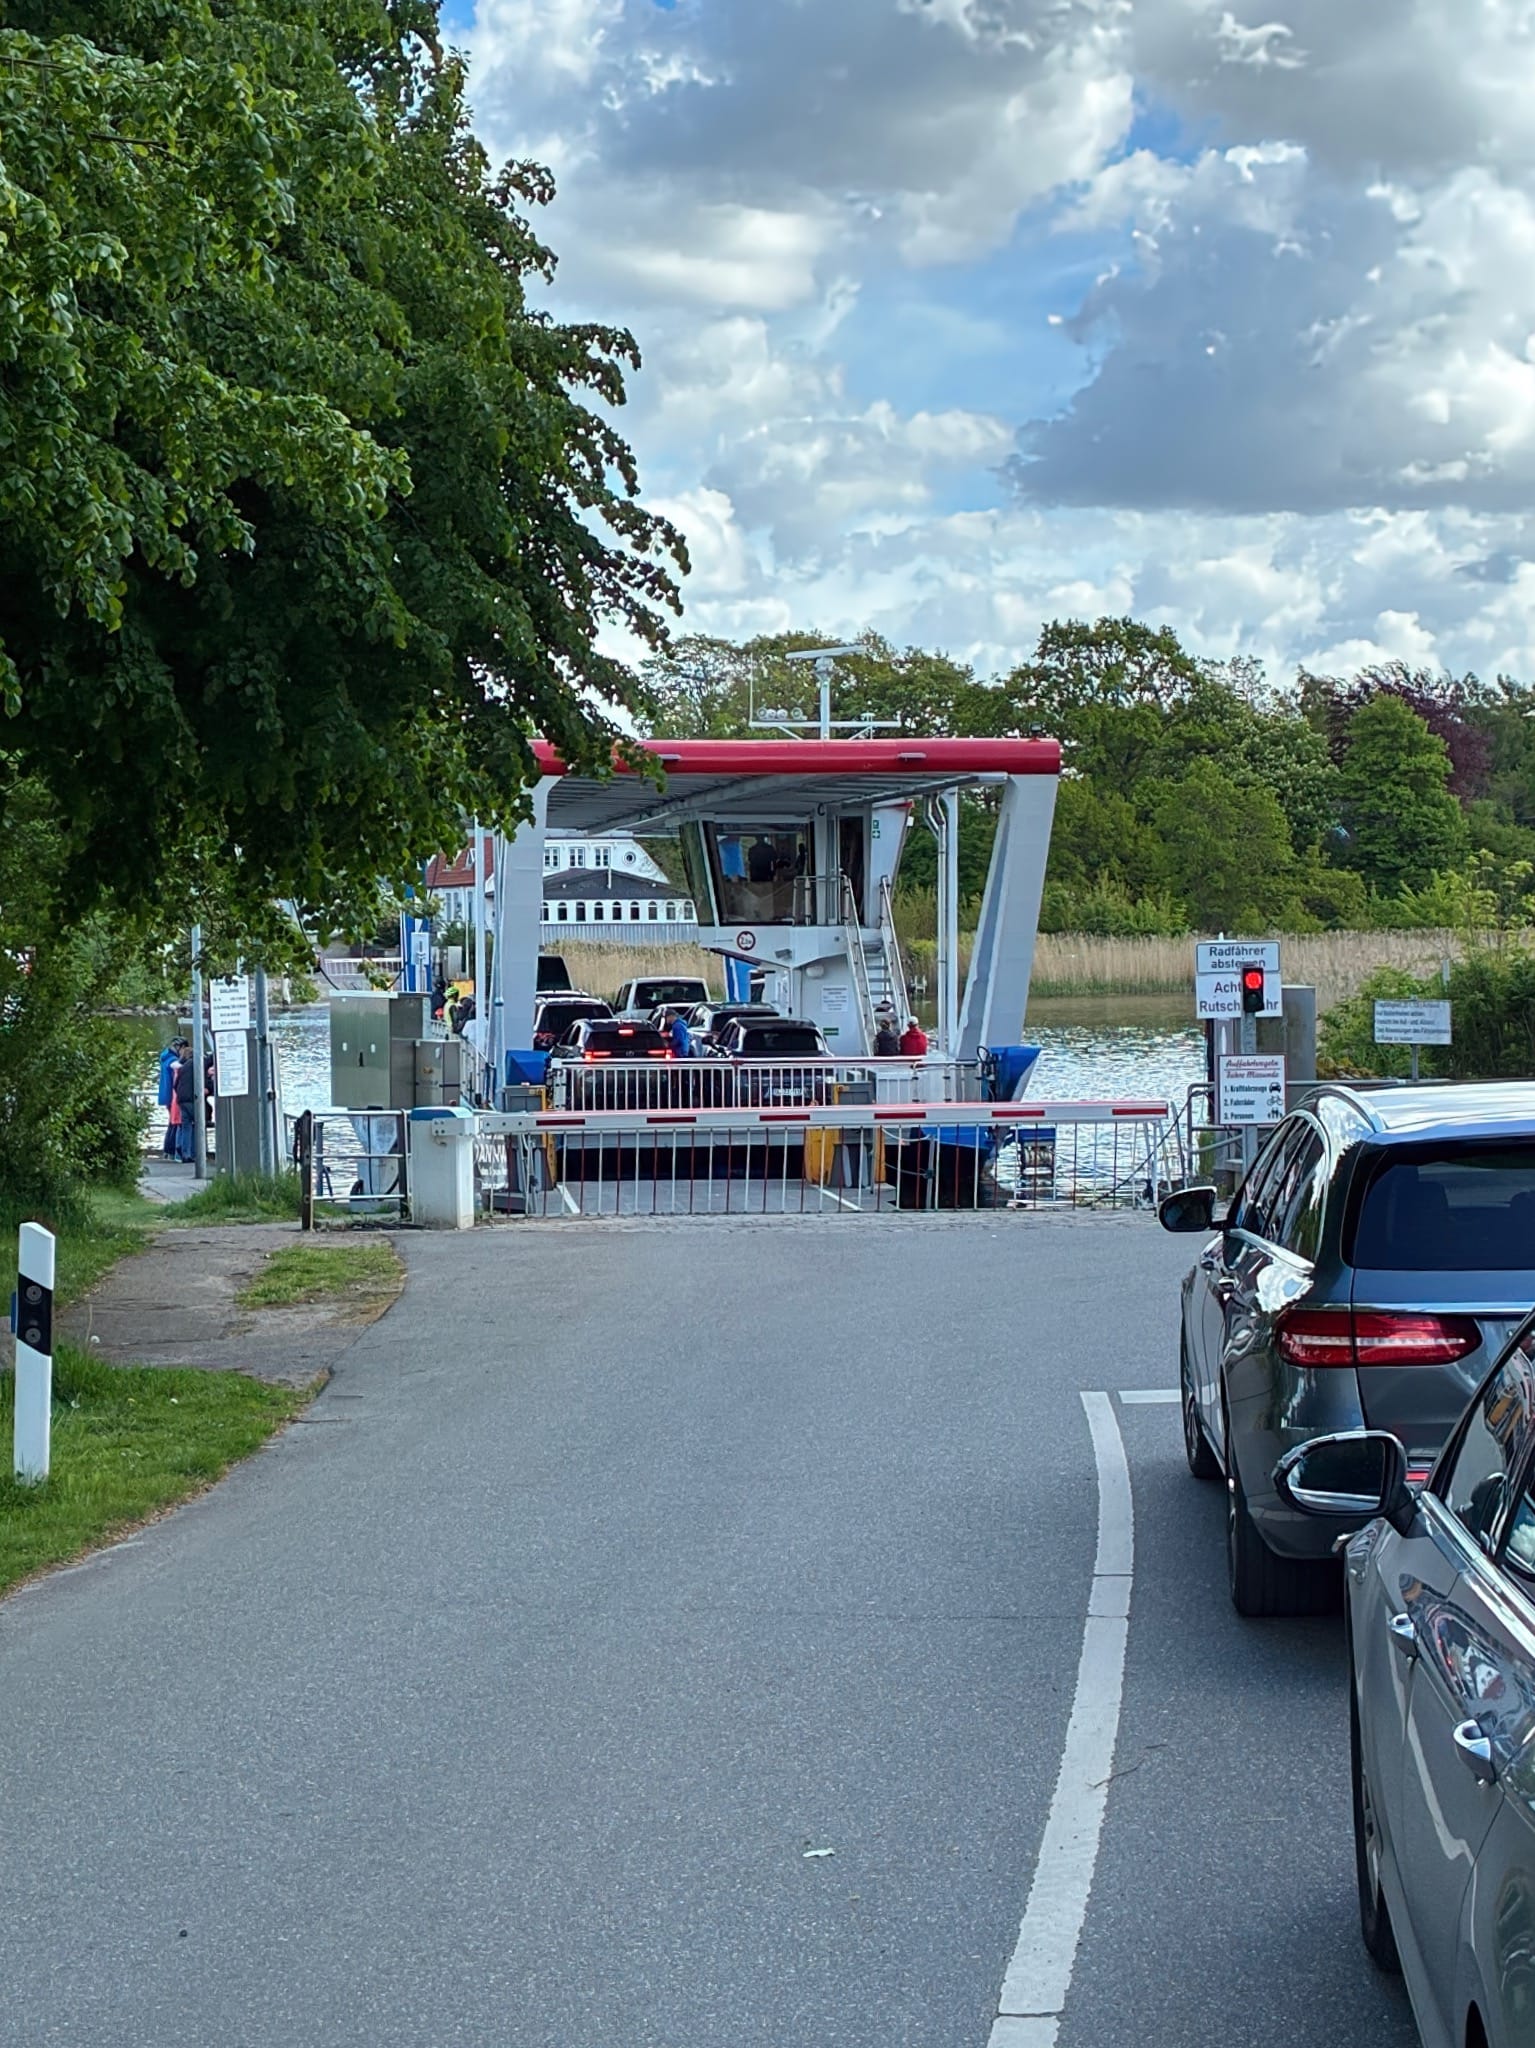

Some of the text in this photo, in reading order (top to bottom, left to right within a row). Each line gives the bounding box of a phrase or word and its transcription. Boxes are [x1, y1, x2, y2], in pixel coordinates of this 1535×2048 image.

[1209, 946, 1266, 957] Radfährer
[1214, 981, 1242, 993] Acht
[1200, 999, 1279, 1013] Rutschhr
